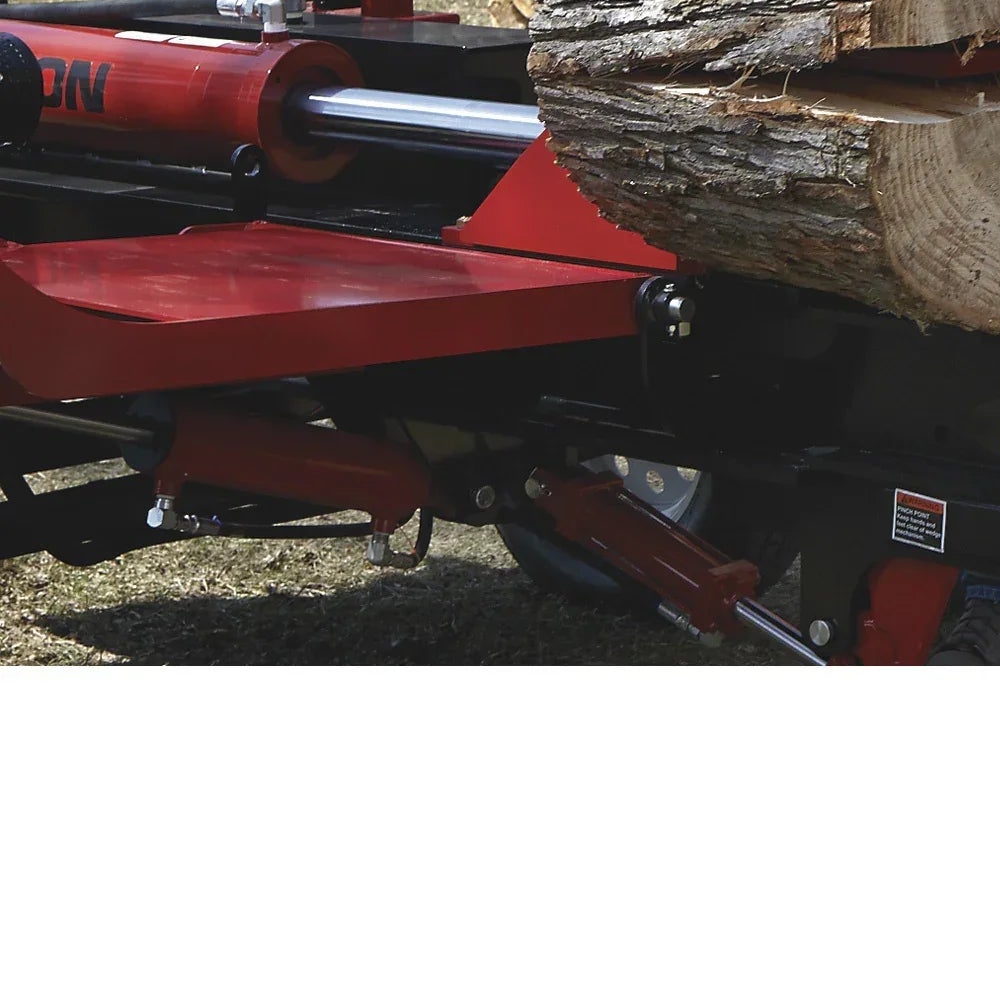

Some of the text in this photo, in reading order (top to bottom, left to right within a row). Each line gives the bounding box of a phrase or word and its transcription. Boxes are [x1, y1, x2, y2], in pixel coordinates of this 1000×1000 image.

[897, 513, 909, 522] Keep
[898, 506, 930, 519] PINCH POINT
